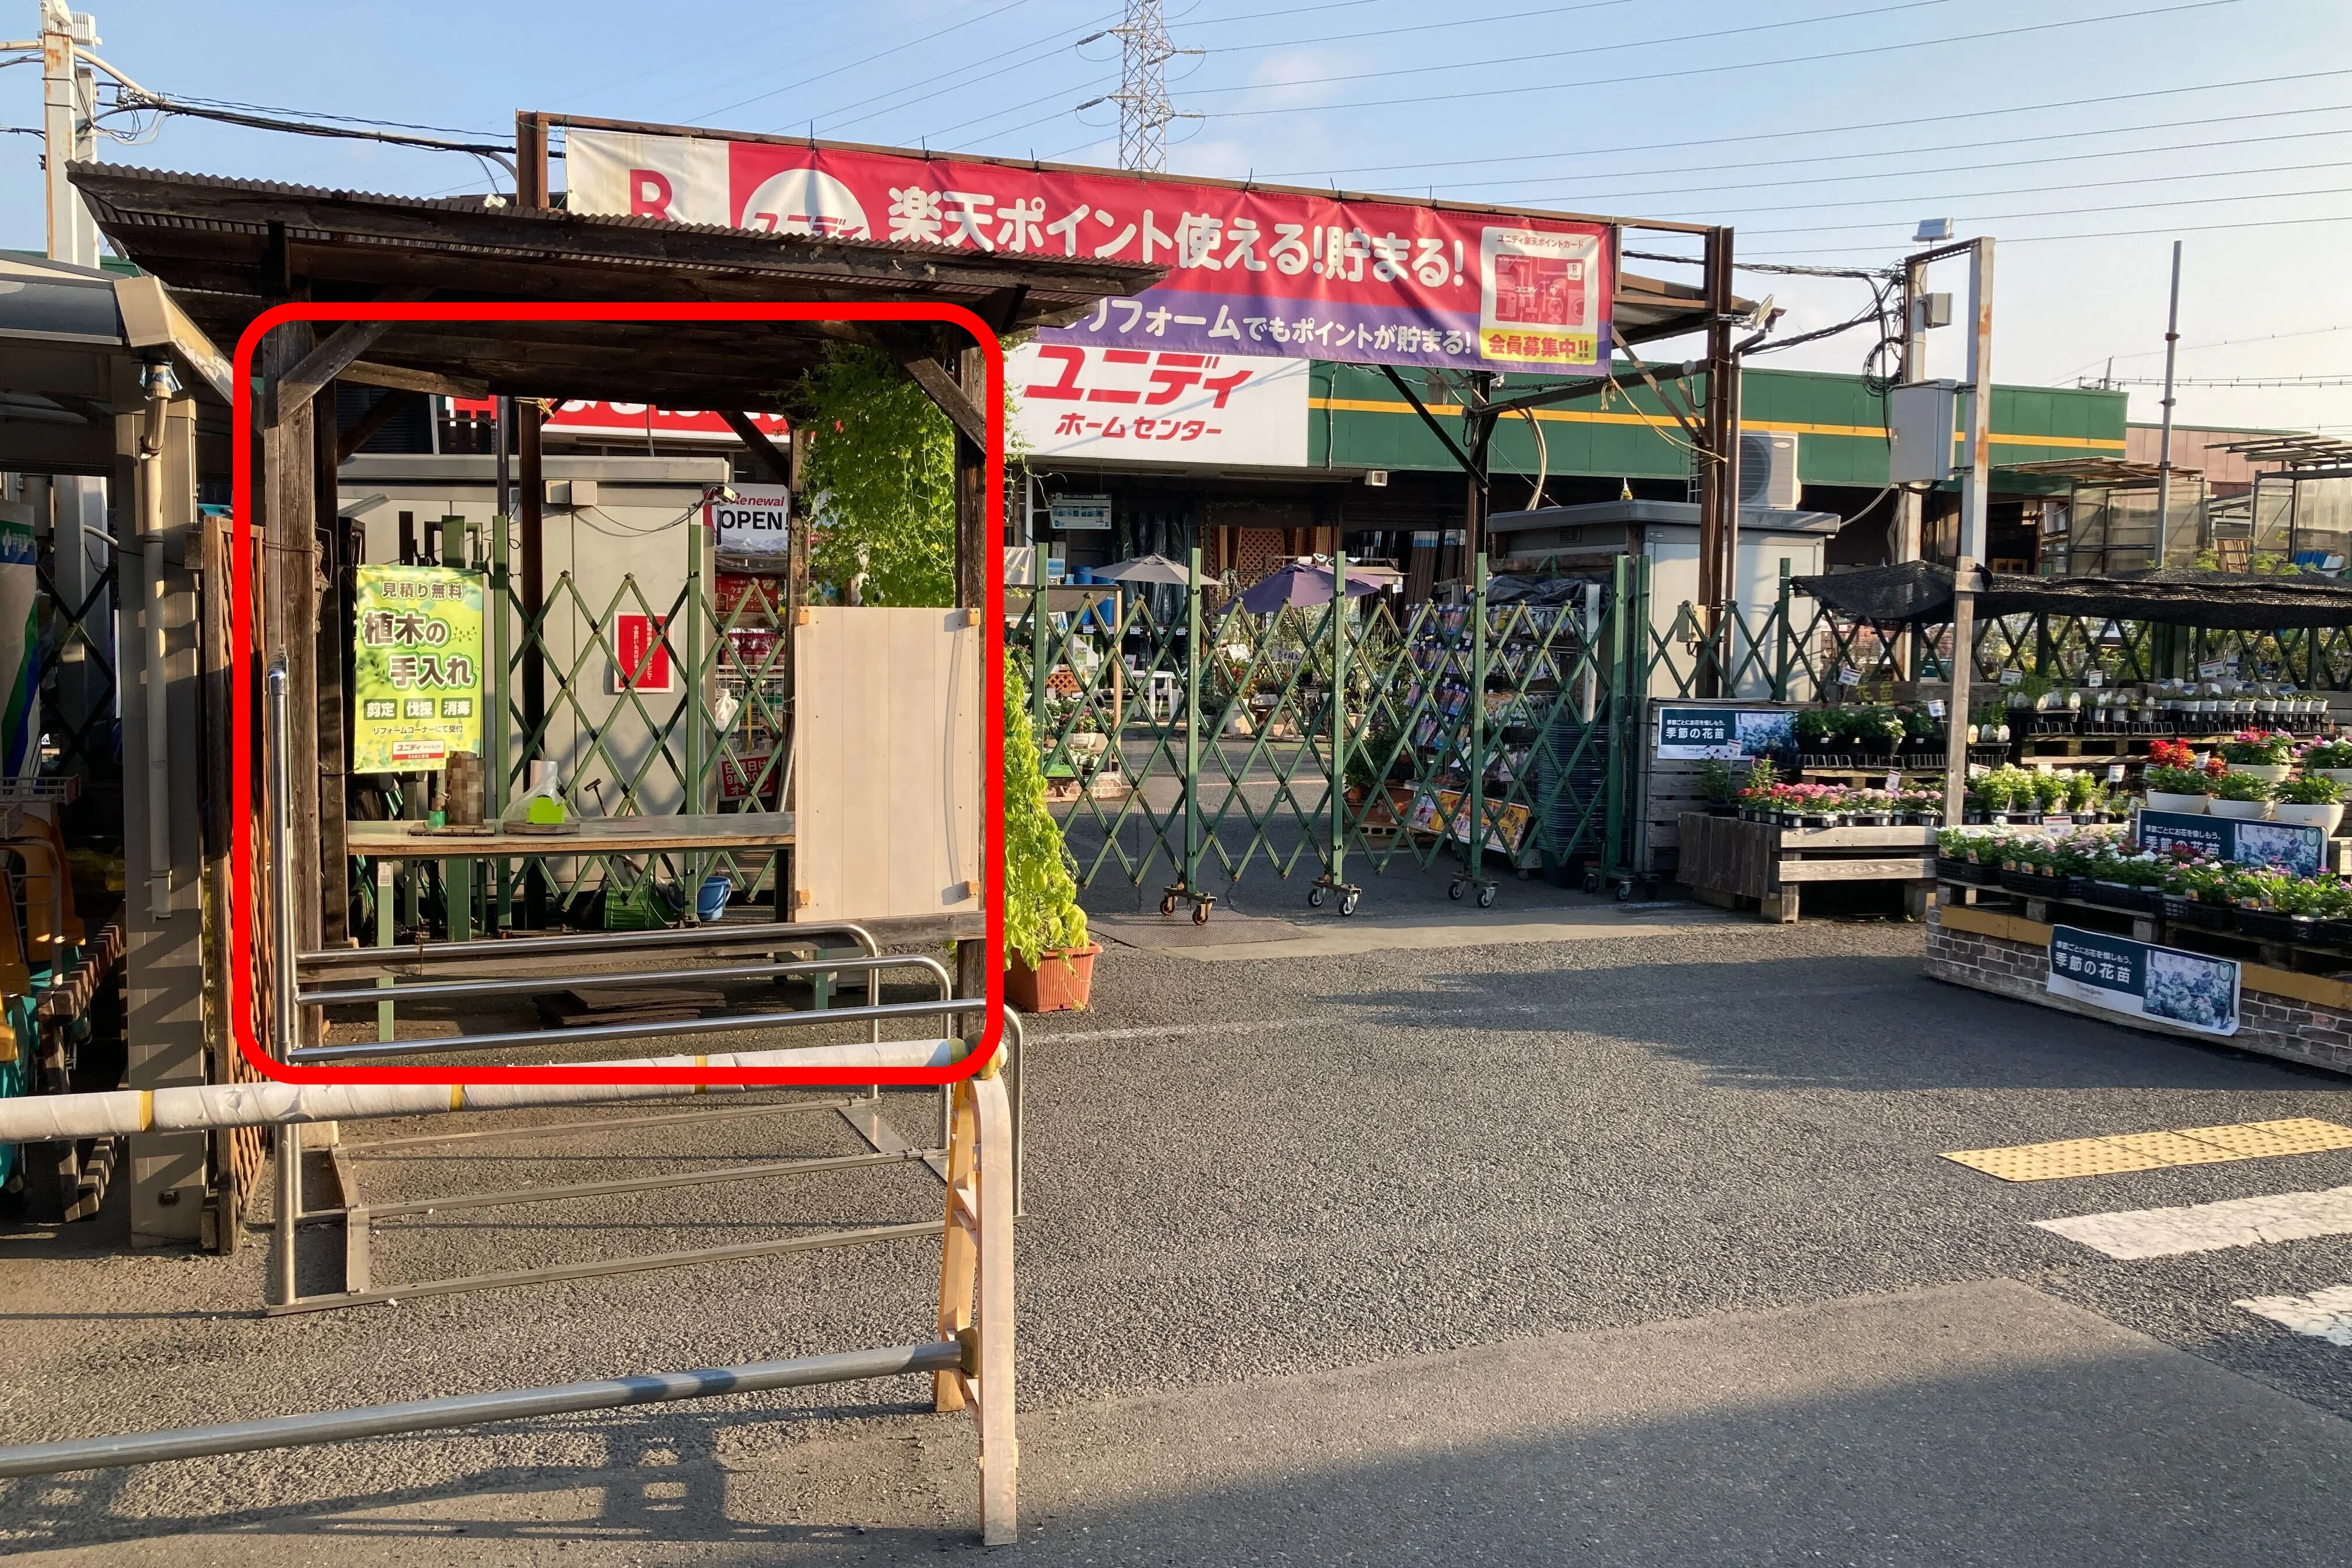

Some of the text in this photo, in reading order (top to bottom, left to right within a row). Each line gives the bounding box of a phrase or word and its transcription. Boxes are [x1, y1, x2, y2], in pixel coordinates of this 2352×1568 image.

[1023, 345, 1254, 410] ユニディ
[1055, 413, 1222, 441] ホームセンター
[383, 582, 463, 599] 見積り無料
[365, 611, 447, 645] 植木の
[390, 657, 471, 687] 手入れ
[443, 700, 470, 716] 消毒
[373, 724, 463, 734] リフォームコーナーにて受付
[1665, 727, 1725, 739] 季節の花苗
[2055, 951, 2131, 984] 季節の花苗
